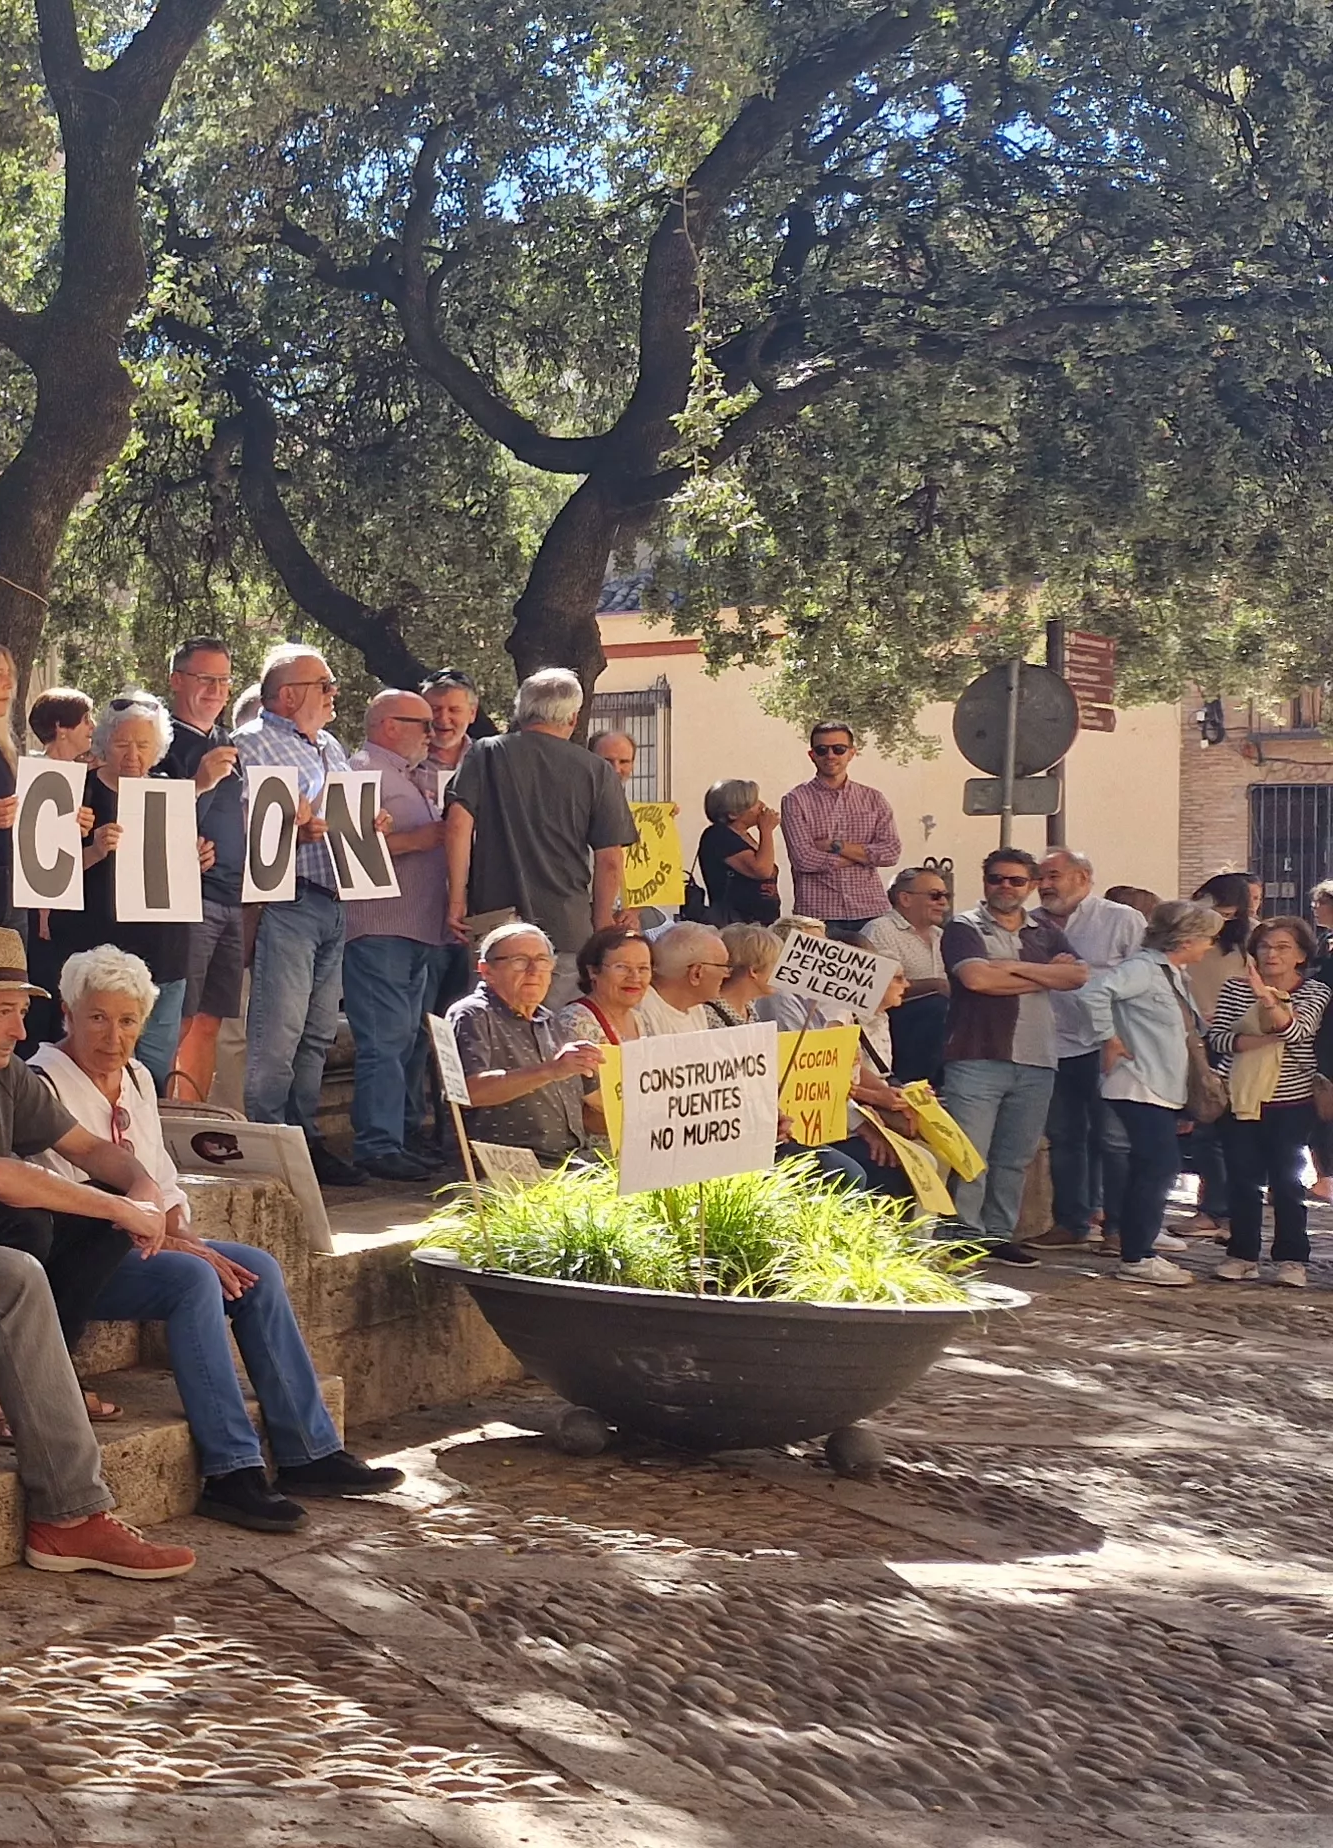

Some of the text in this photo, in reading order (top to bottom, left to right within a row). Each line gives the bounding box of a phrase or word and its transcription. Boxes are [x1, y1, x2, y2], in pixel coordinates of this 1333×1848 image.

[786, 949, 874, 990] PERSONA
[793, 933, 877, 973] NINGUNA
[774, 965, 869, 1010] ES ILEGAL
[639, 1053, 767, 1095] CONSTRUYAMOS
[794, 1081, 831, 1102] DIGNA
[668, 1086, 742, 1119] PUENTES
[650, 1117, 741, 1151] NO MUROS
